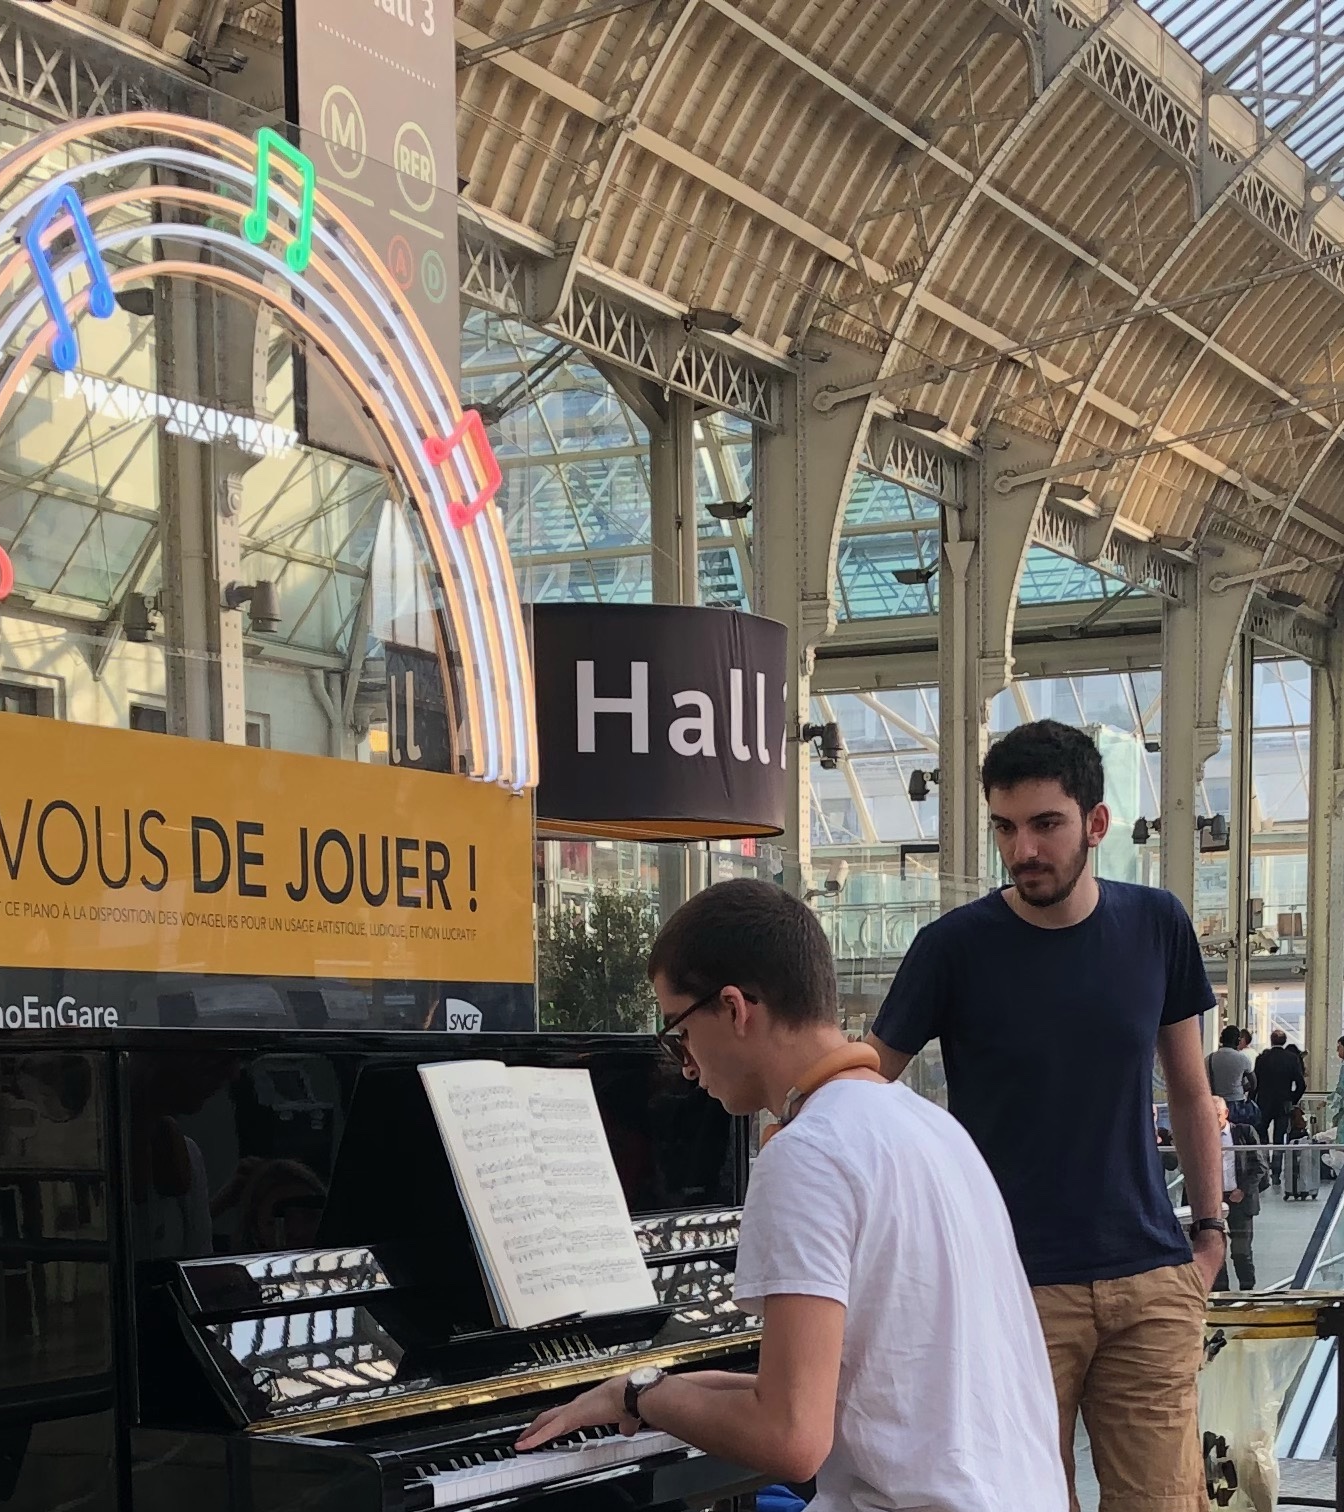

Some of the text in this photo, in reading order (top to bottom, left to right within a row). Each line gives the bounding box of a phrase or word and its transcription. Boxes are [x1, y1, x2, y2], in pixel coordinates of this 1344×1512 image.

[373, 0, 435, 36] all 3
[331, 102, 356, 160] M
[576, 659, 770, 766] Hall
[191, 815, 267, 897] DE
[285, 827, 452, 911] JOUER
[468, 844, 477, 913] !
[6, 901, 21, 917] CE
[23, 902, 60, 919] PIANO
[62, 901, 71, 920] À
[73, 904, 87, 920] LA
[89, 906, 156, 925] DISPOSITION
[158, 910, 178, 925] DES
[180, 911, 239, 929] VOYAGEURS
[241, 915, 267, 931] POUR
[268, 917, 283, 931] UN
[285, 918, 315, 933] USAGE
[409, 925, 420, 938] ET
[421, 926, 440, 940] NON
[449, 1014, 479, 1030] SNCF
[529, 1334, 600, 1366] YAMAHA
